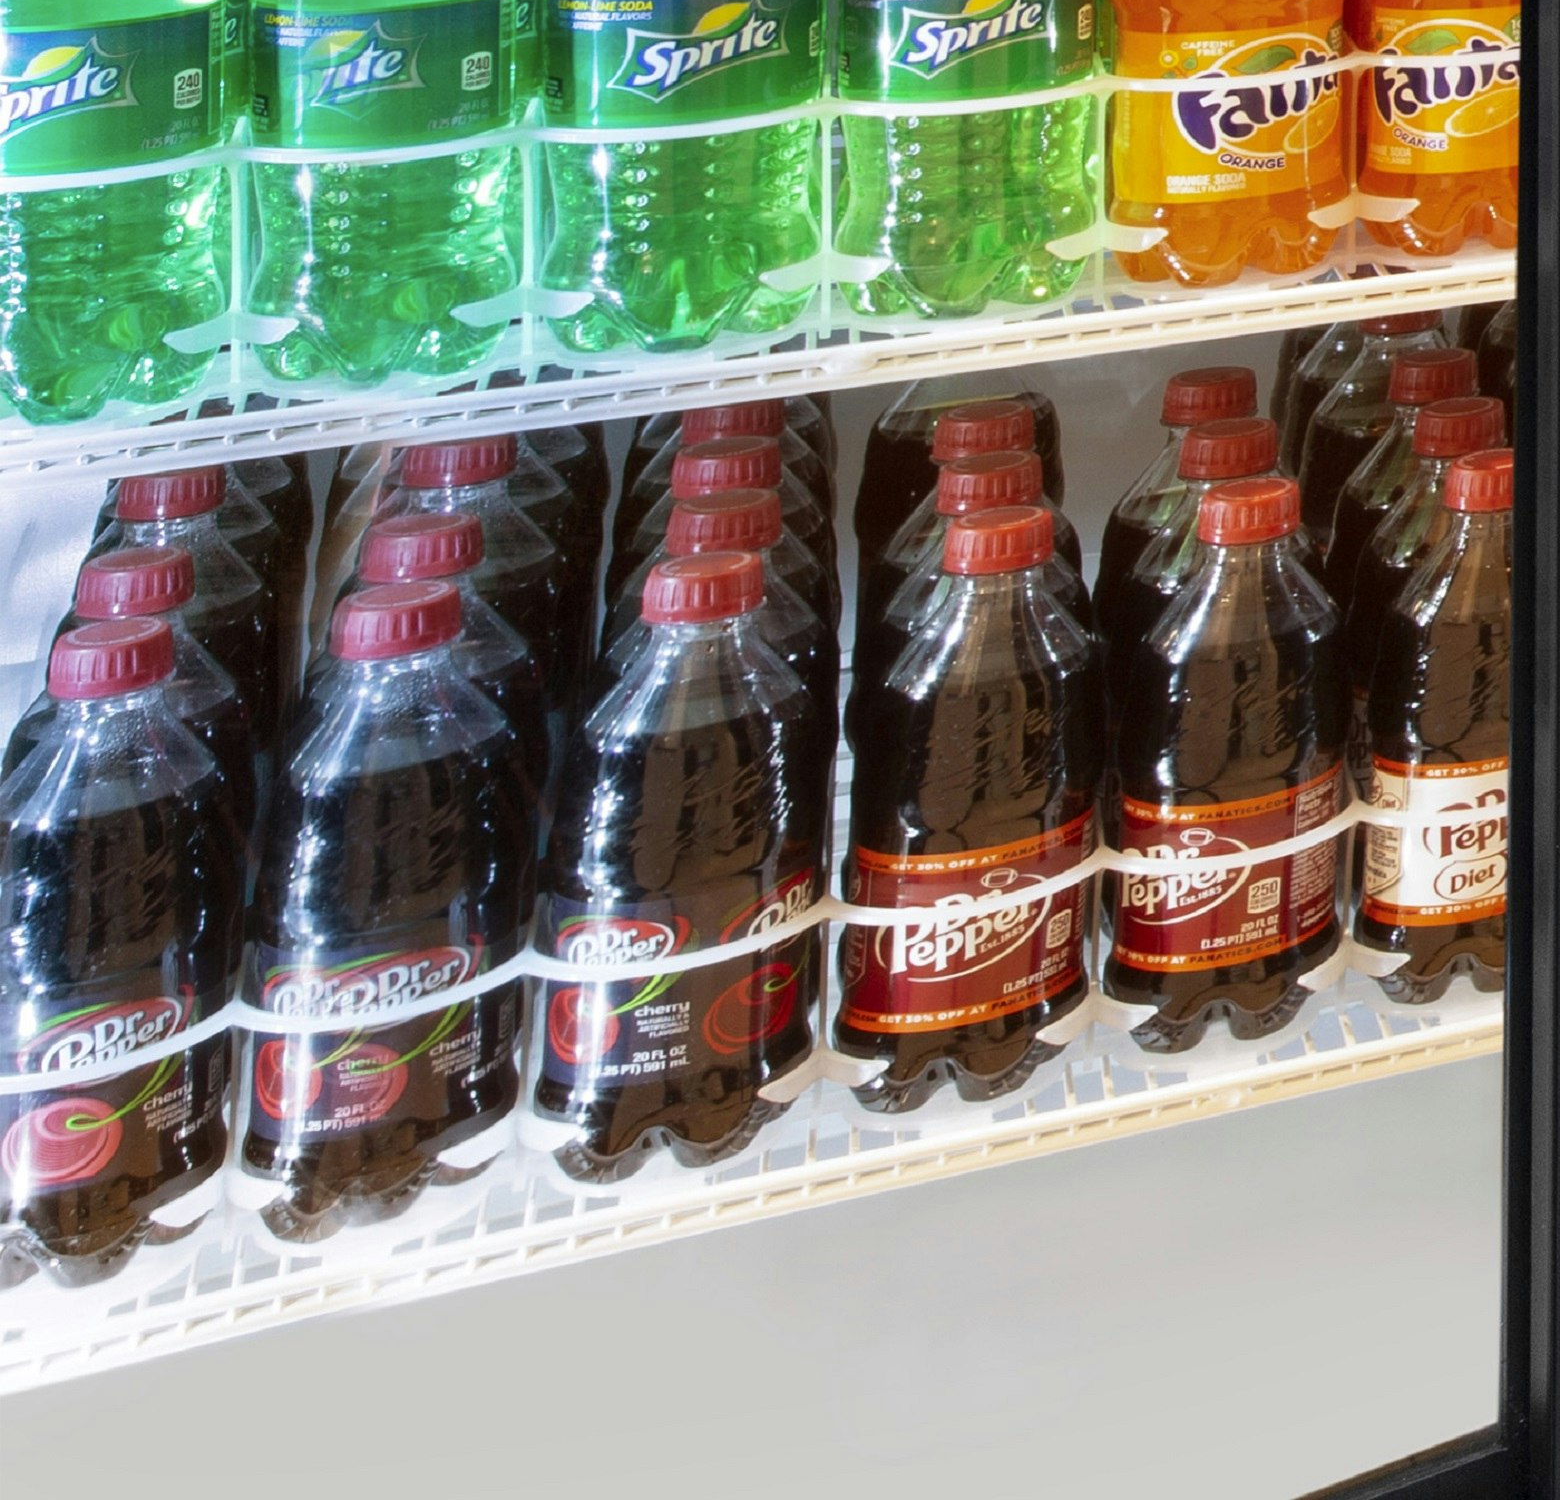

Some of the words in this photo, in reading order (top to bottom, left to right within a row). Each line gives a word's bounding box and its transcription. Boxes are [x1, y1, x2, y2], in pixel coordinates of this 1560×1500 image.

[616, 0, 654, 12] SODA
[903, 0, 1043, 64] Sprite
[627, 13, 779, 90] Sprite
[1179, 39, 1236, 51] CAFFEINE
[1196, 47, 1226, 57] FREE
[465, 55, 491, 75] 240
[176, 73, 201, 91] 240
[1392, 127, 1447, 151] ORANGE
[1218, 152, 1286, 171] ORANGE
[948, 857, 977, 869] OFF
[981, 854, 999, 866] AT
[1450, 863, 1497, 894] Diet
[1250, 880, 1280, 899] 250
[601, 922, 639, 952] Dr
[889, 902, 1036, 975] Pepper
[1170, 955, 1187, 965] AT
[1188, 937, 1285, 964] FANATICS.COM
[634, 1000, 692, 1019] cherry
[877, 1011, 903, 1024] GET
[936, 1008, 966, 1022] OFF
[968, 1004, 988, 1015] AT
[95, 1004, 145, 1044] Dr
[632, 1050, 650, 1064] 20
[651, 1048, 667, 1063] FL
[669, 1045, 688, 1060] OZ
[142, 1083, 194, 1113] cherry
